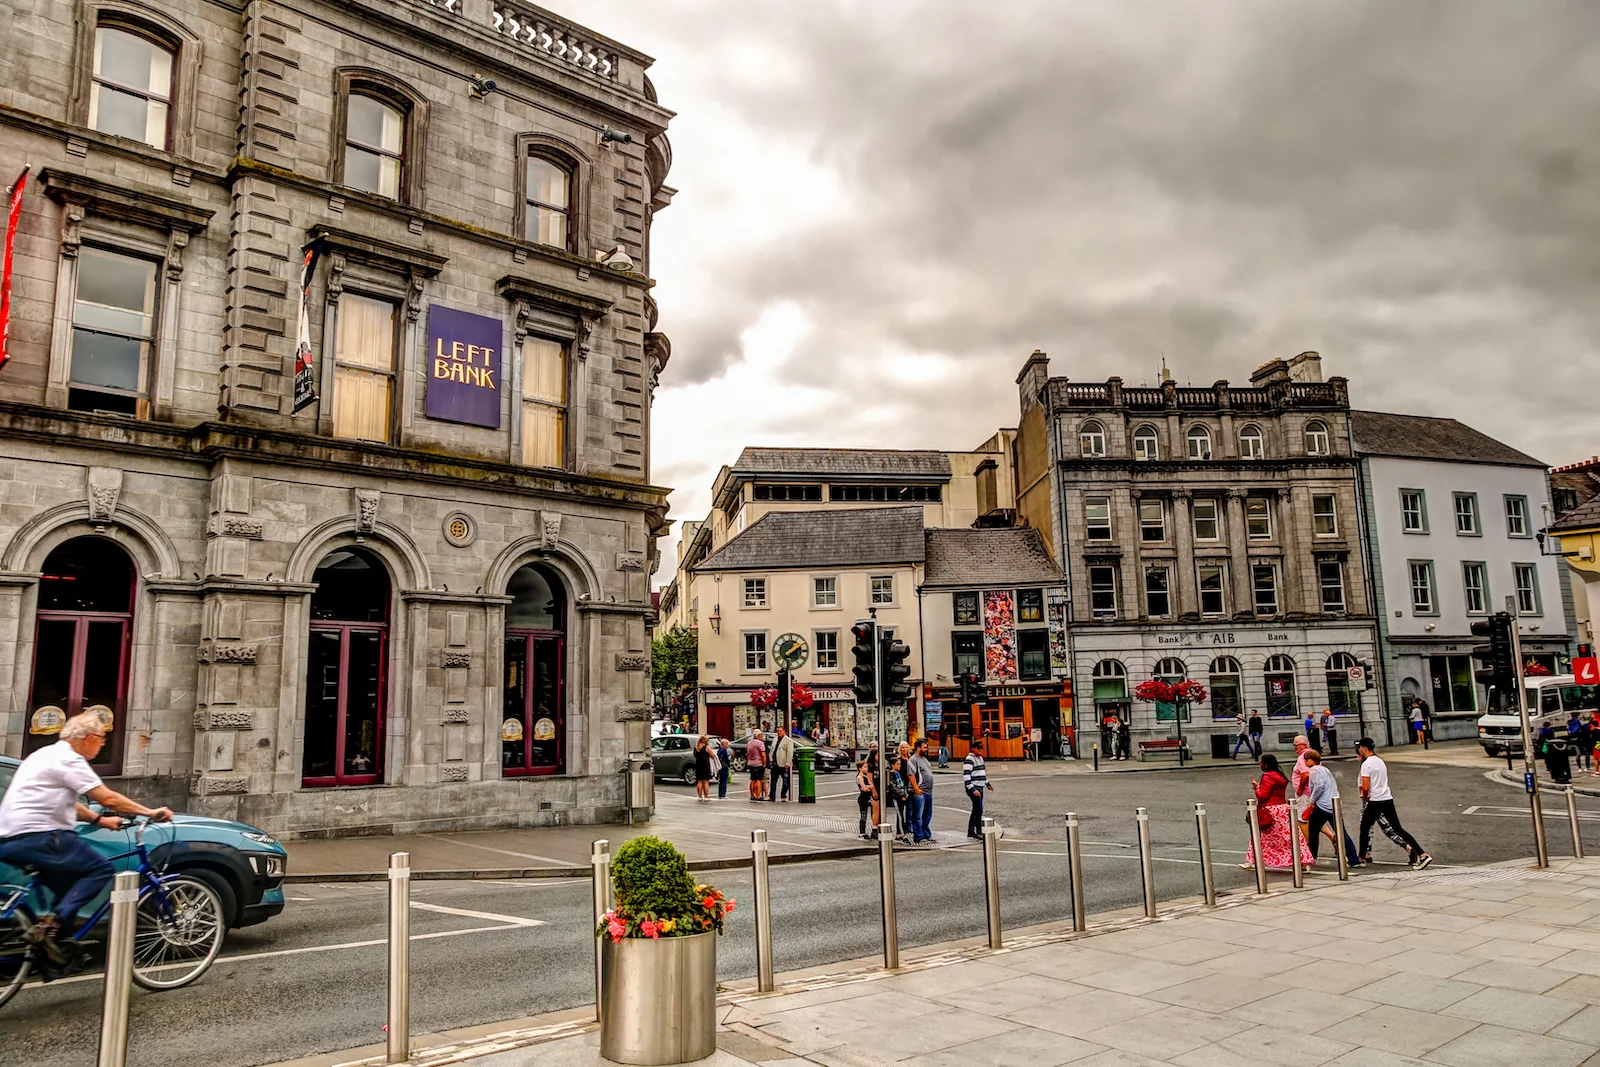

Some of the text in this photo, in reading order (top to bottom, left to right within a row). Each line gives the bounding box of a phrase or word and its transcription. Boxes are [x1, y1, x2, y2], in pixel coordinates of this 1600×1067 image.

[437, 338, 495, 367] LEFT
[434, 359, 496, 390] BANK
[1158, 633, 1289, 644] Bank AIB Bank
[995, 686, 1027, 697] FIELD
